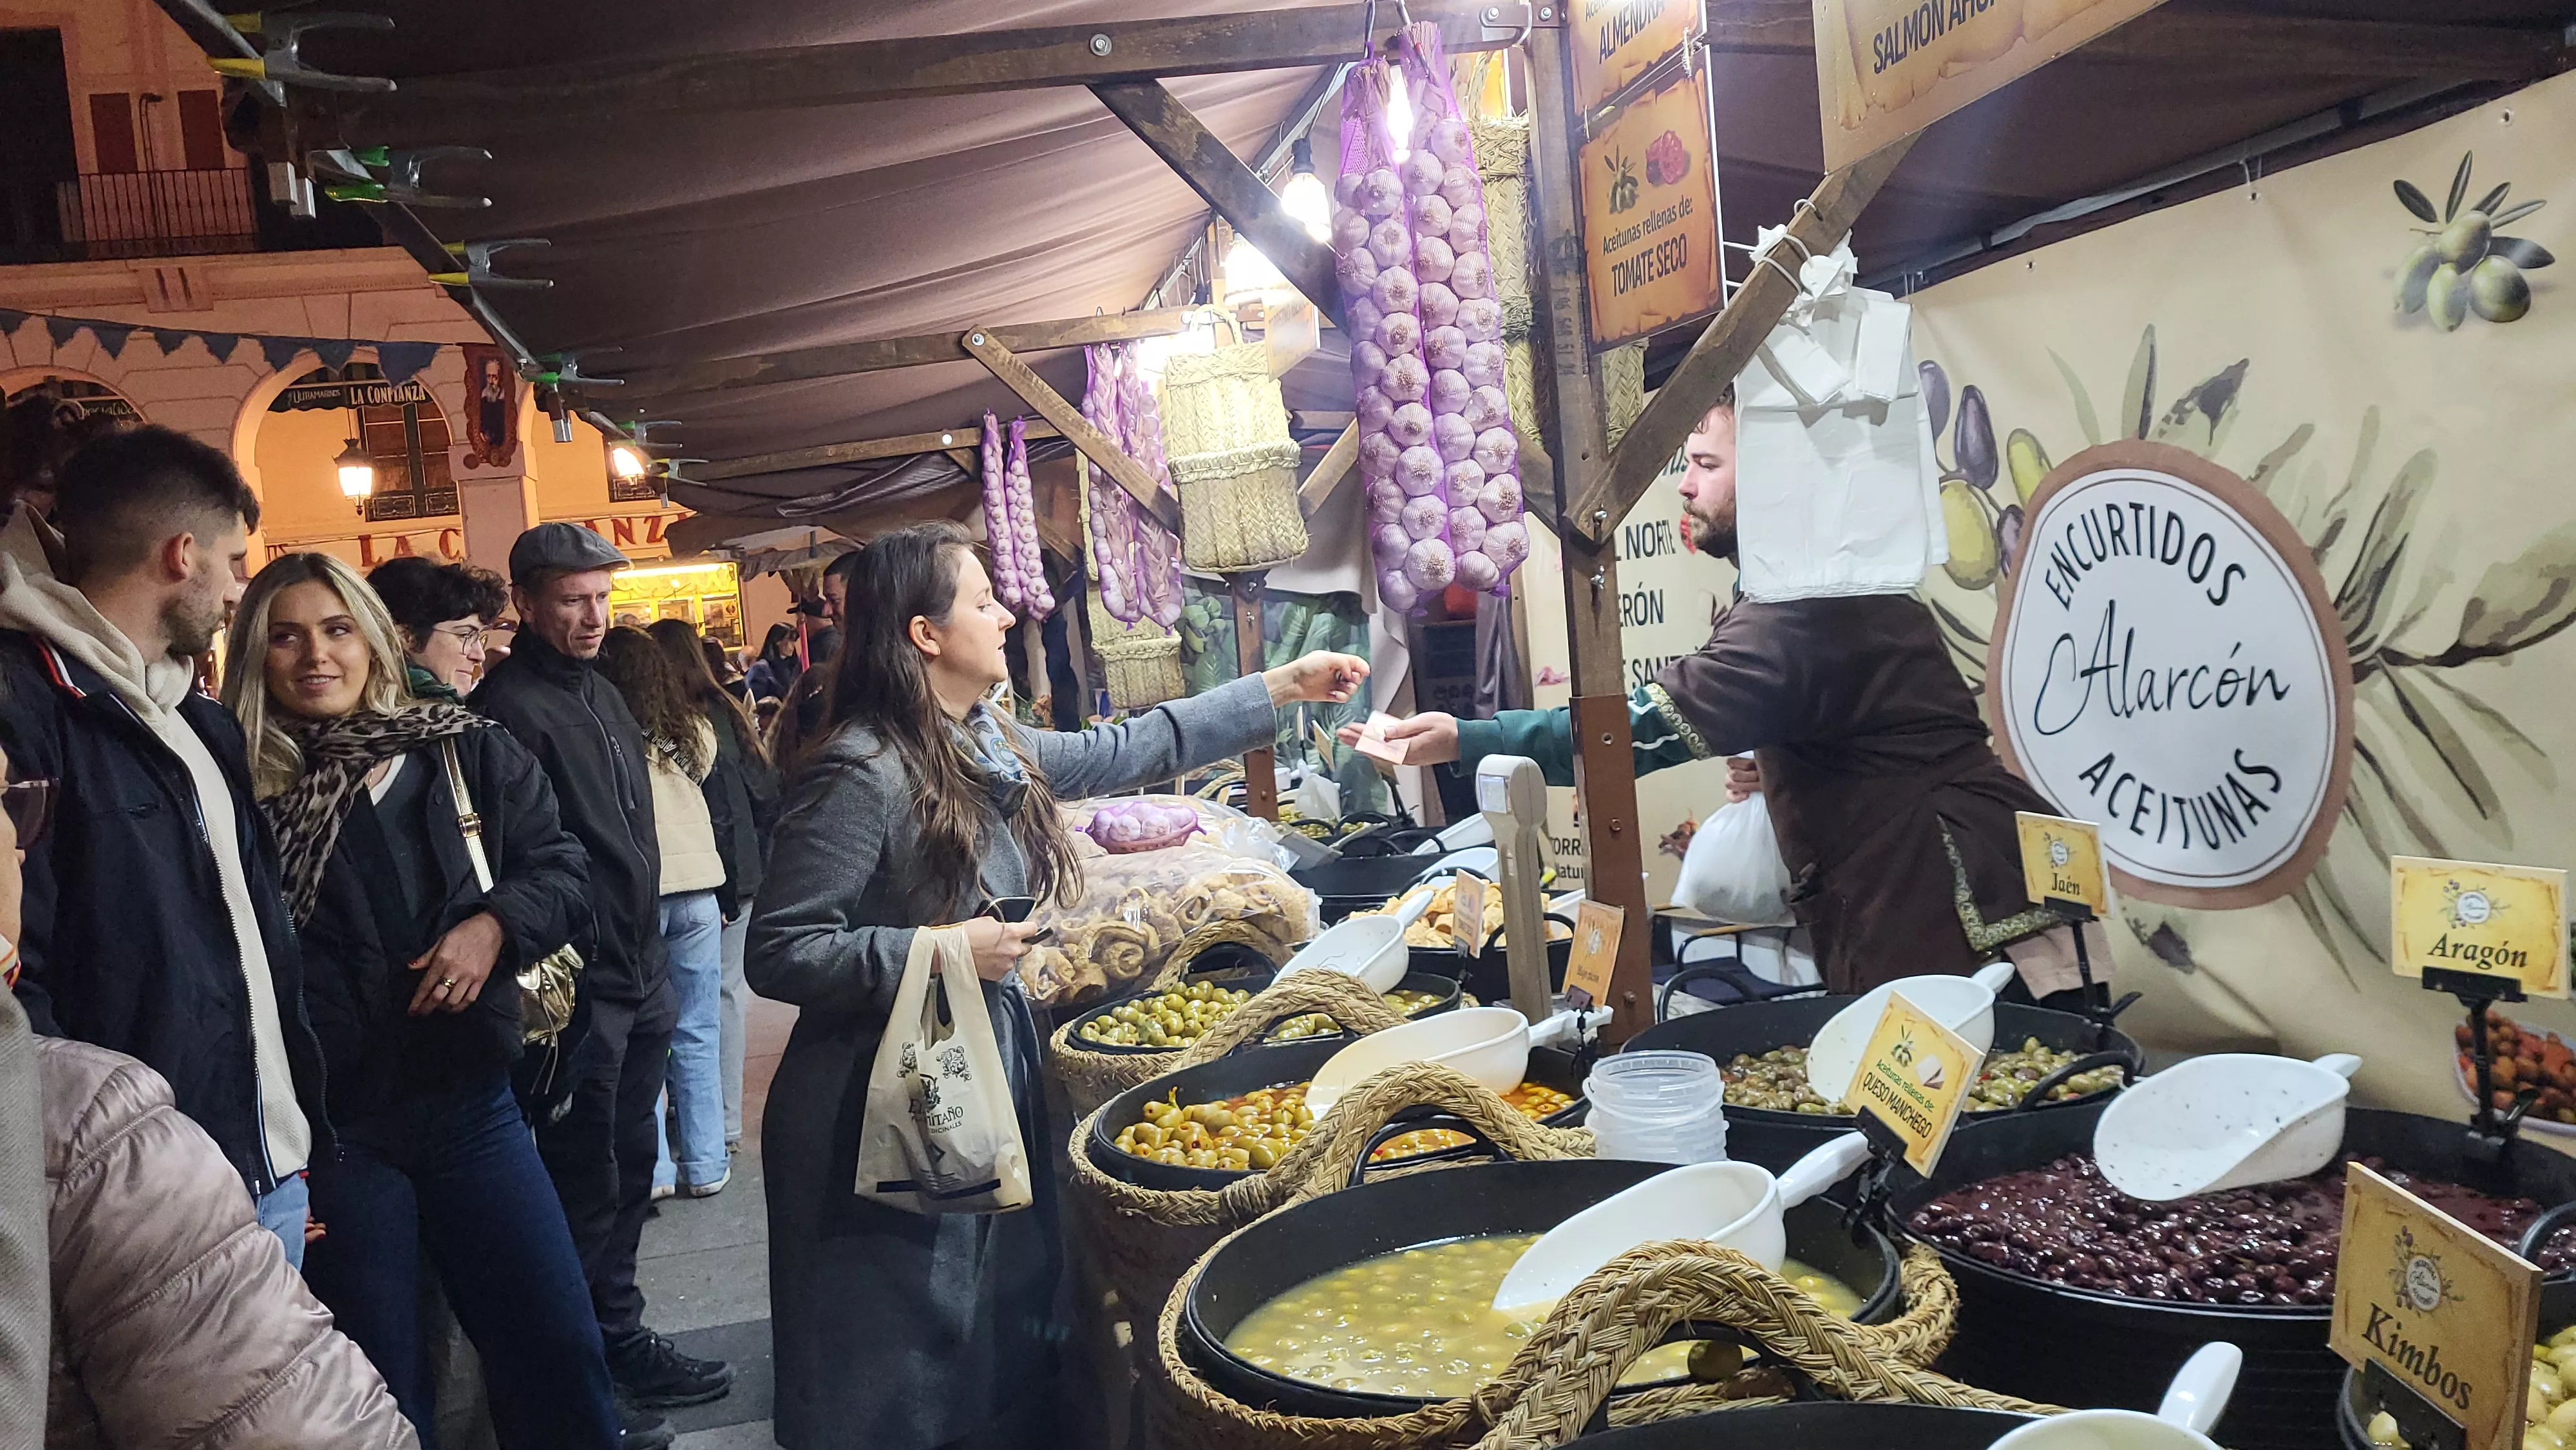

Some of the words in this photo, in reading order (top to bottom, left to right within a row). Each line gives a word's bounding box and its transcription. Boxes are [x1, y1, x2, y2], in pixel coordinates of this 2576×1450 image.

[1603, 223, 1642, 256] Aceitunas
[1642, 204, 1676, 236] rellenas
[1679, 194, 1693, 218] de:
[1612, 248, 1654, 297] TOMATE
[1656, 232, 1687, 278] SECO
[350, 386, 364, 405] LA
[367, 384, 426, 404] CONFIANZA
[2045, 502, 2246, 611] ENCURTIDOS
[2034, 599, 2290, 735] Alarcón
[2078, 748, 2283, 850] ACEITUNAS
[2051, 872, 2081, 896] Jaén
[2427, 933, 2528, 970] Aragón
[1863, 1071, 1890, 1102] QUESO
[1886, 1091, 1933, 1138] MANCHEGO
[1877, 1059, 1902, 1086] Aceitunas
[1901, 1080, 1925, 1105] rellenas
[2362, 1303, 2473, 1410] Kimbos
